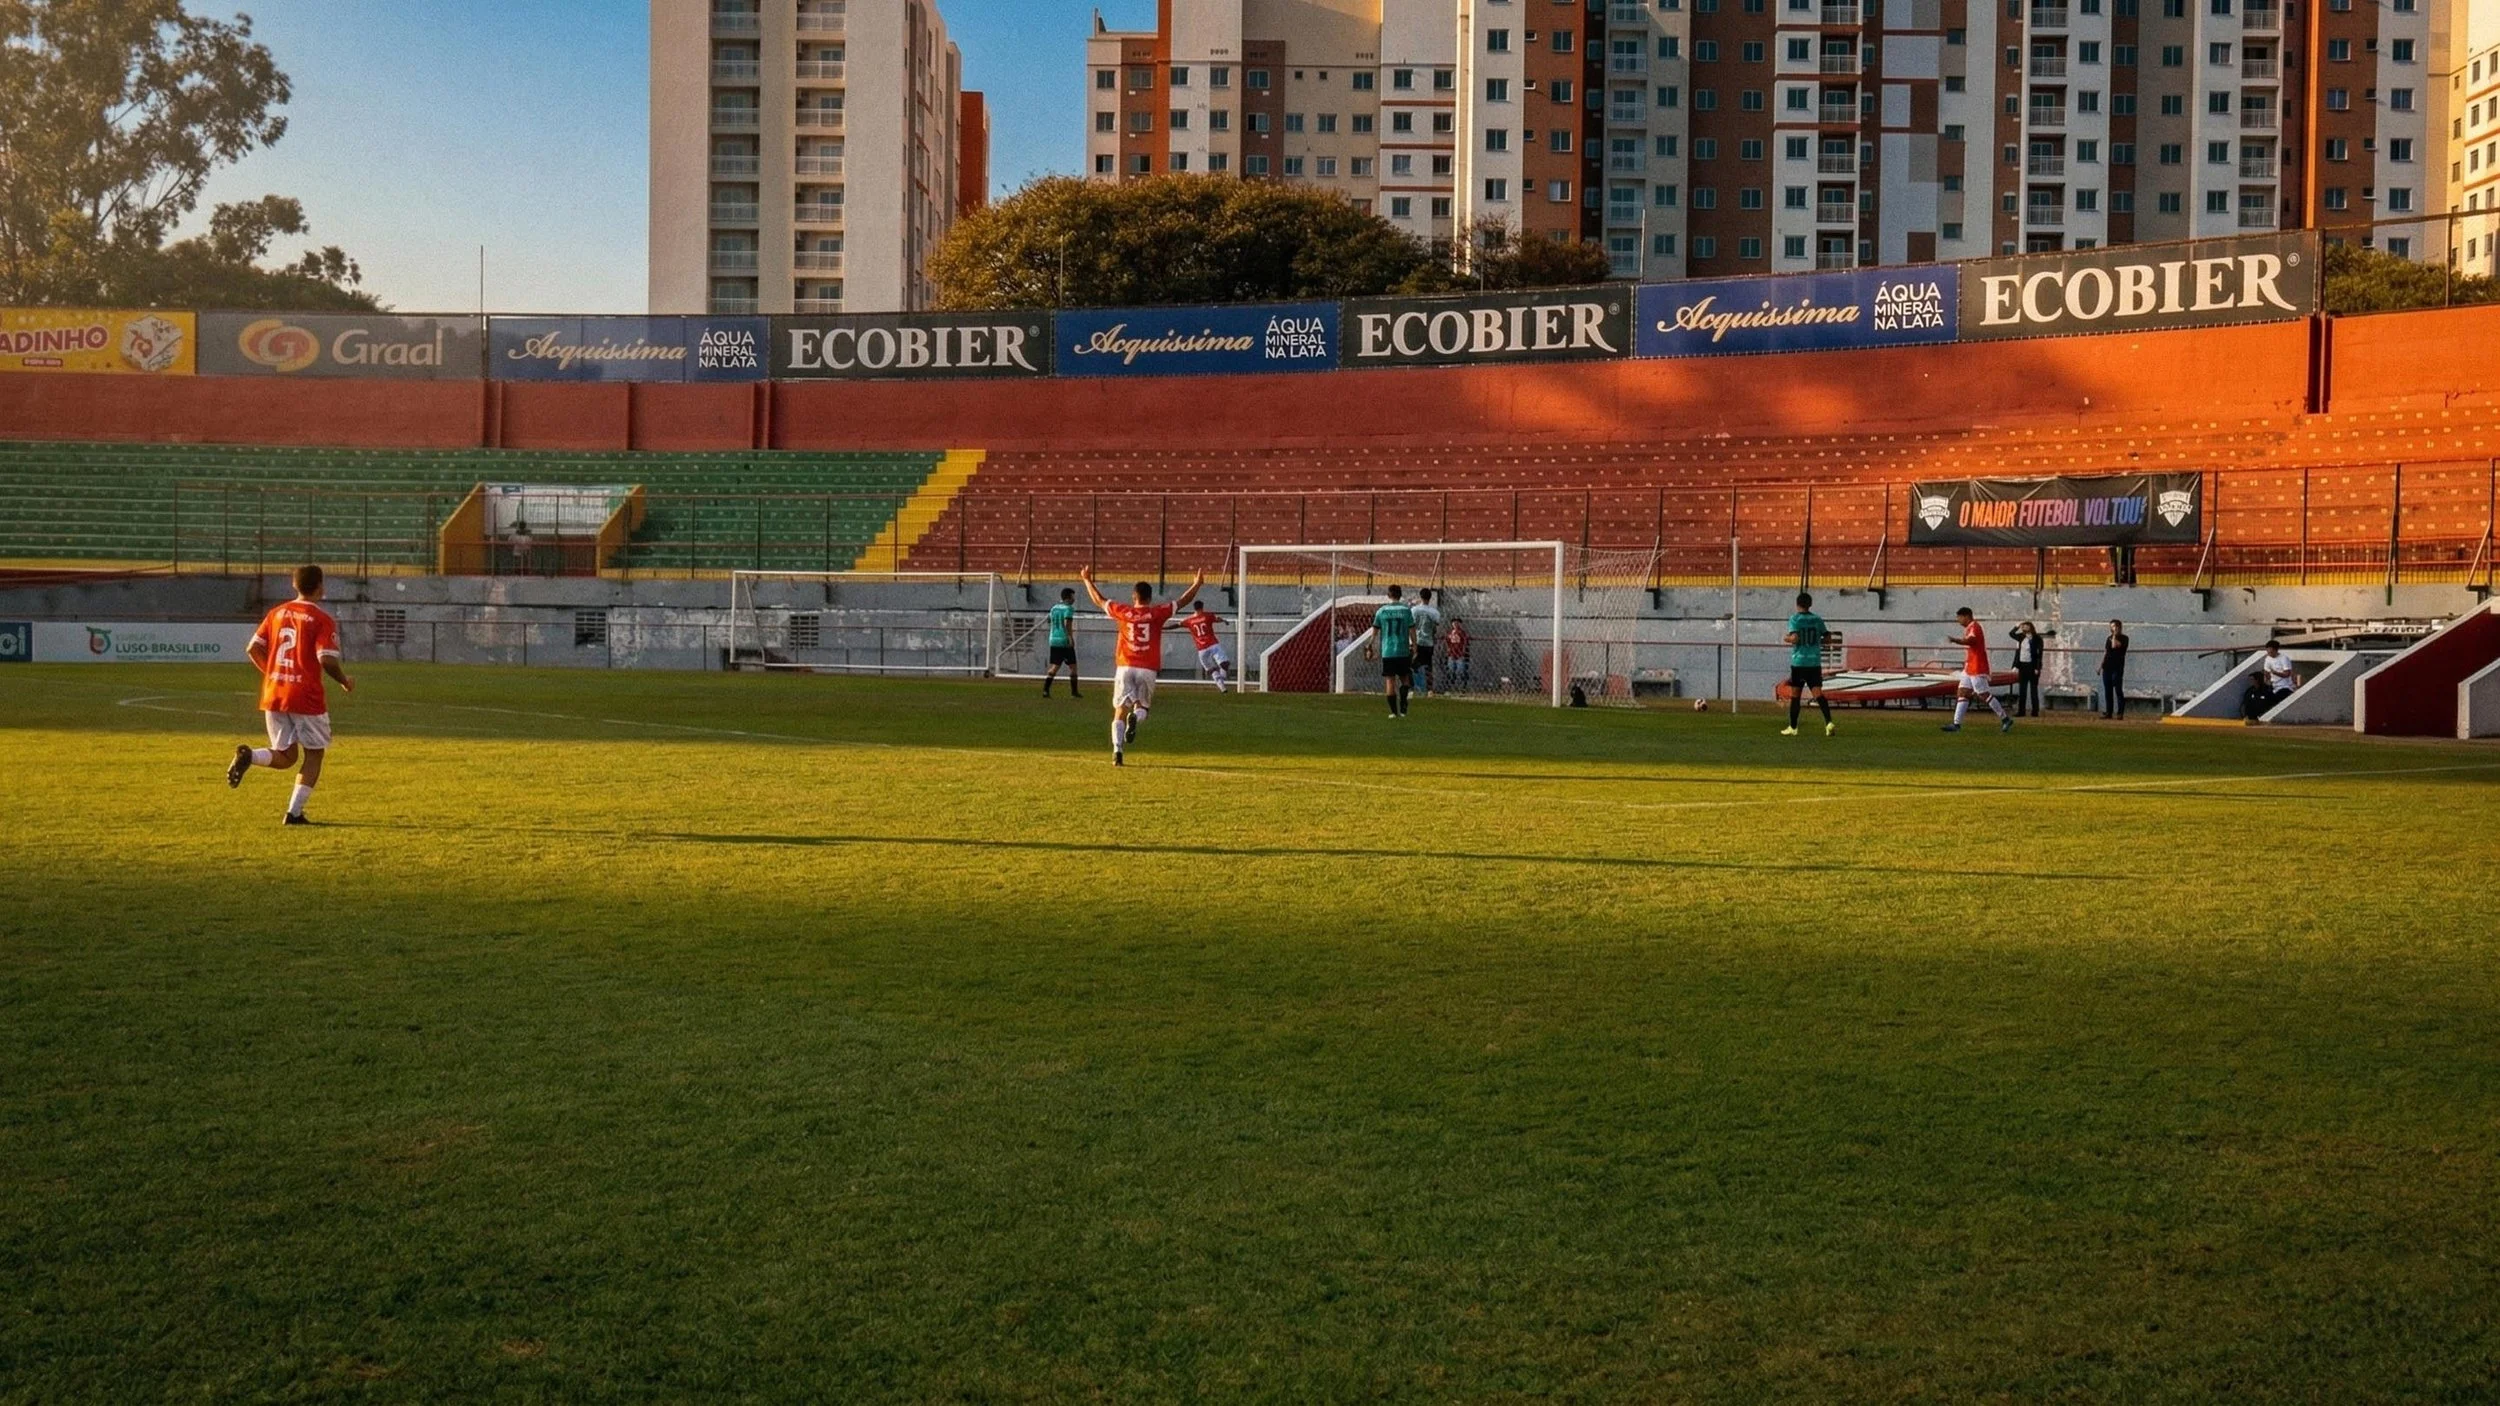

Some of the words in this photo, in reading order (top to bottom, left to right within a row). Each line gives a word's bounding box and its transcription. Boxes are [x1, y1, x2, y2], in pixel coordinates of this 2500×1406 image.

[1979, 253, 2297, 326] ECOBIER
[1656, 296, 1860, 343] Acquissima
[1874, 300, 1944, 317] MINERAL
[1874, 316, 1898, 331] NA
[1902, 313, 1944, 329] LATA
[1073, 323, 1255, 366] Acquissima
[1265, 333, 1327, 347] MINERAL
[1357, 303, 1618, 357] ECOBIER
[332, 328, 443, 366] Graal
[508, 330, 688, 371] Acquissima
[698, 345, 757, 357] MINERAL
[787, 325, 1038, 372] ECOBIER
[1265, 346, 1287, 359] NA
[1290, 344, 1327, 358] LATA
[698, 356, 719, 369] NA
[722, 356, 758, 368] LATA
[1959, 500, 1971, 528] O
[1971, 500, 2018, 528] MAIOR
[2018, 499, 2081, 527] FUTEBOL
[1126, 622, 1150, 643] 13
[115, 642, 148, 654] LUSO
[151, 642, 221, 654] BRASILEIRO
[275, 627, 298, 669] 2
